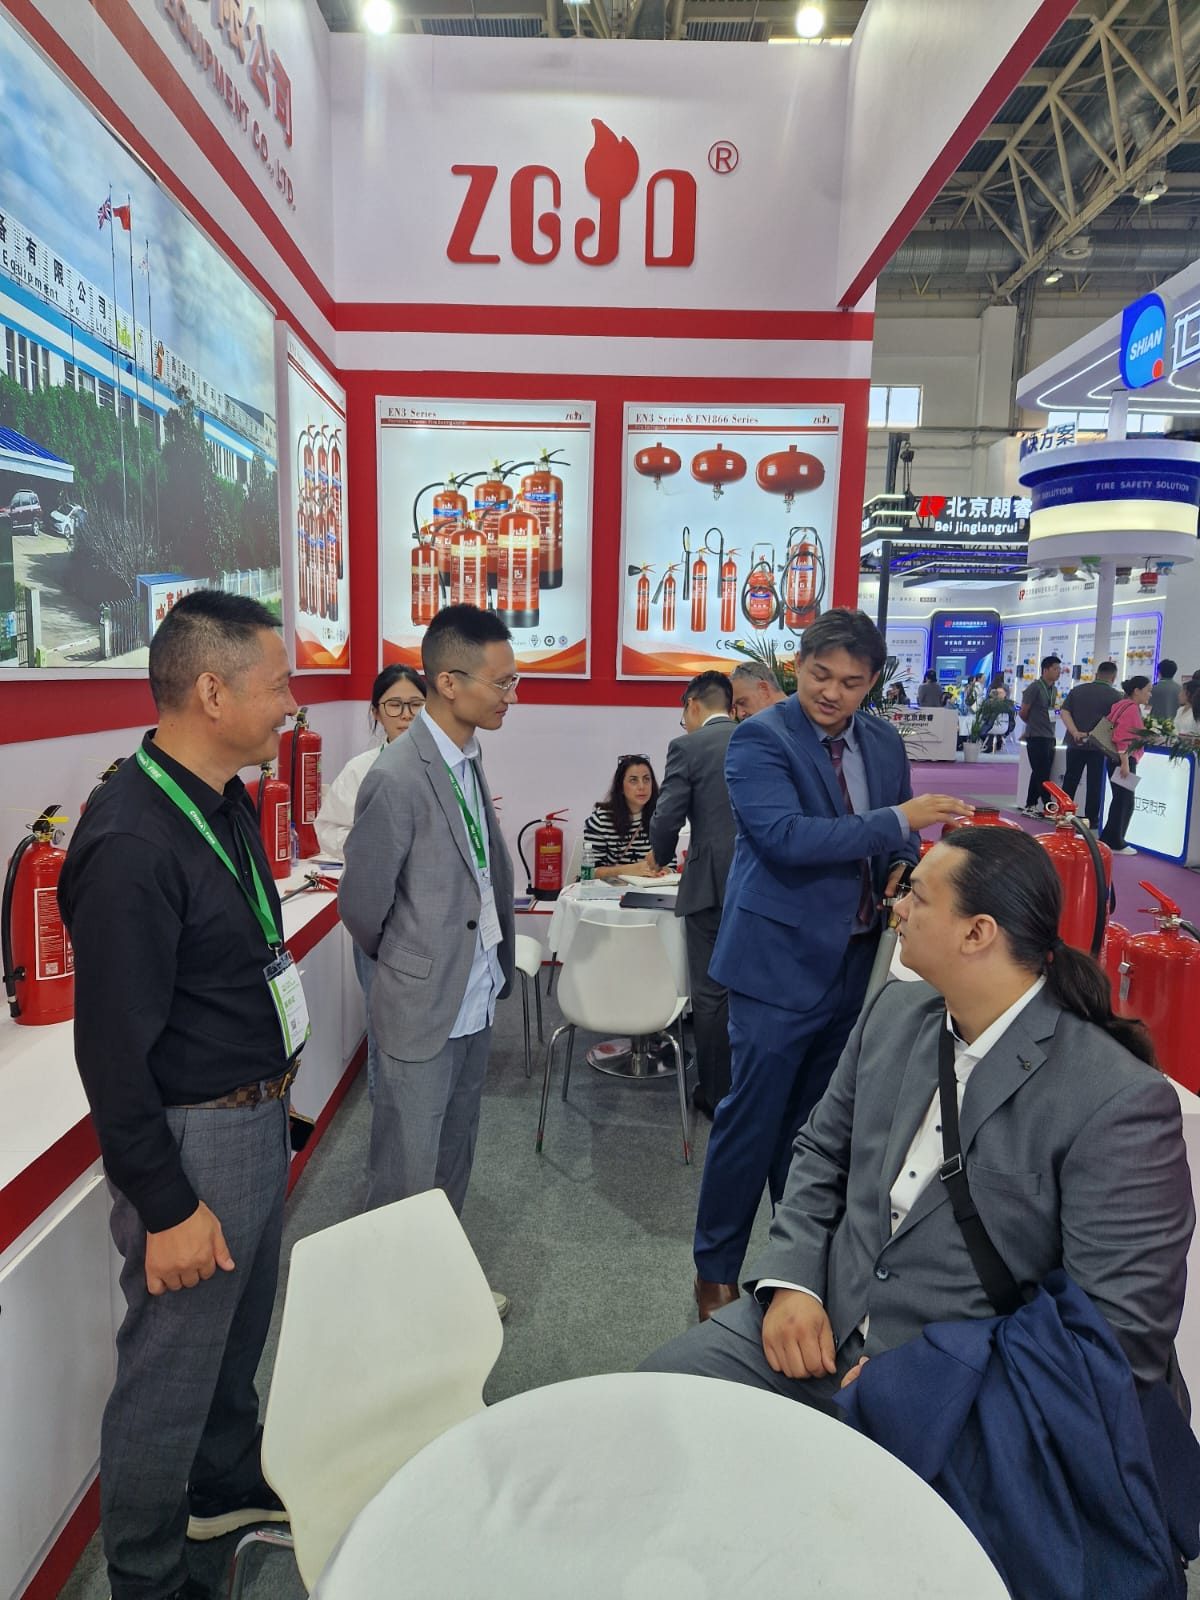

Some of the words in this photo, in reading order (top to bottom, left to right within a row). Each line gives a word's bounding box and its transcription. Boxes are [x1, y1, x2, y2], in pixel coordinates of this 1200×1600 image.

[1129, 326, 1163, 361] SHIAN
[388, 407, 407, 417] EN3
[410, 408, 437, 418] Series
[635, 412, 654, 423] EN3
[658, 414, 684, 424] Series
[685, 413, 693, 423] &
[731, 413, 759, 425] Series
[1096, 481, 1116, 491] FIRE
[1120, 480, 1153, 490] SAFETY
[1155, 480, 1190, 492] SOLUTION
[946, 496, 1033, 519] 北京朗睿
[189, 810, 204, 830] CHINA
